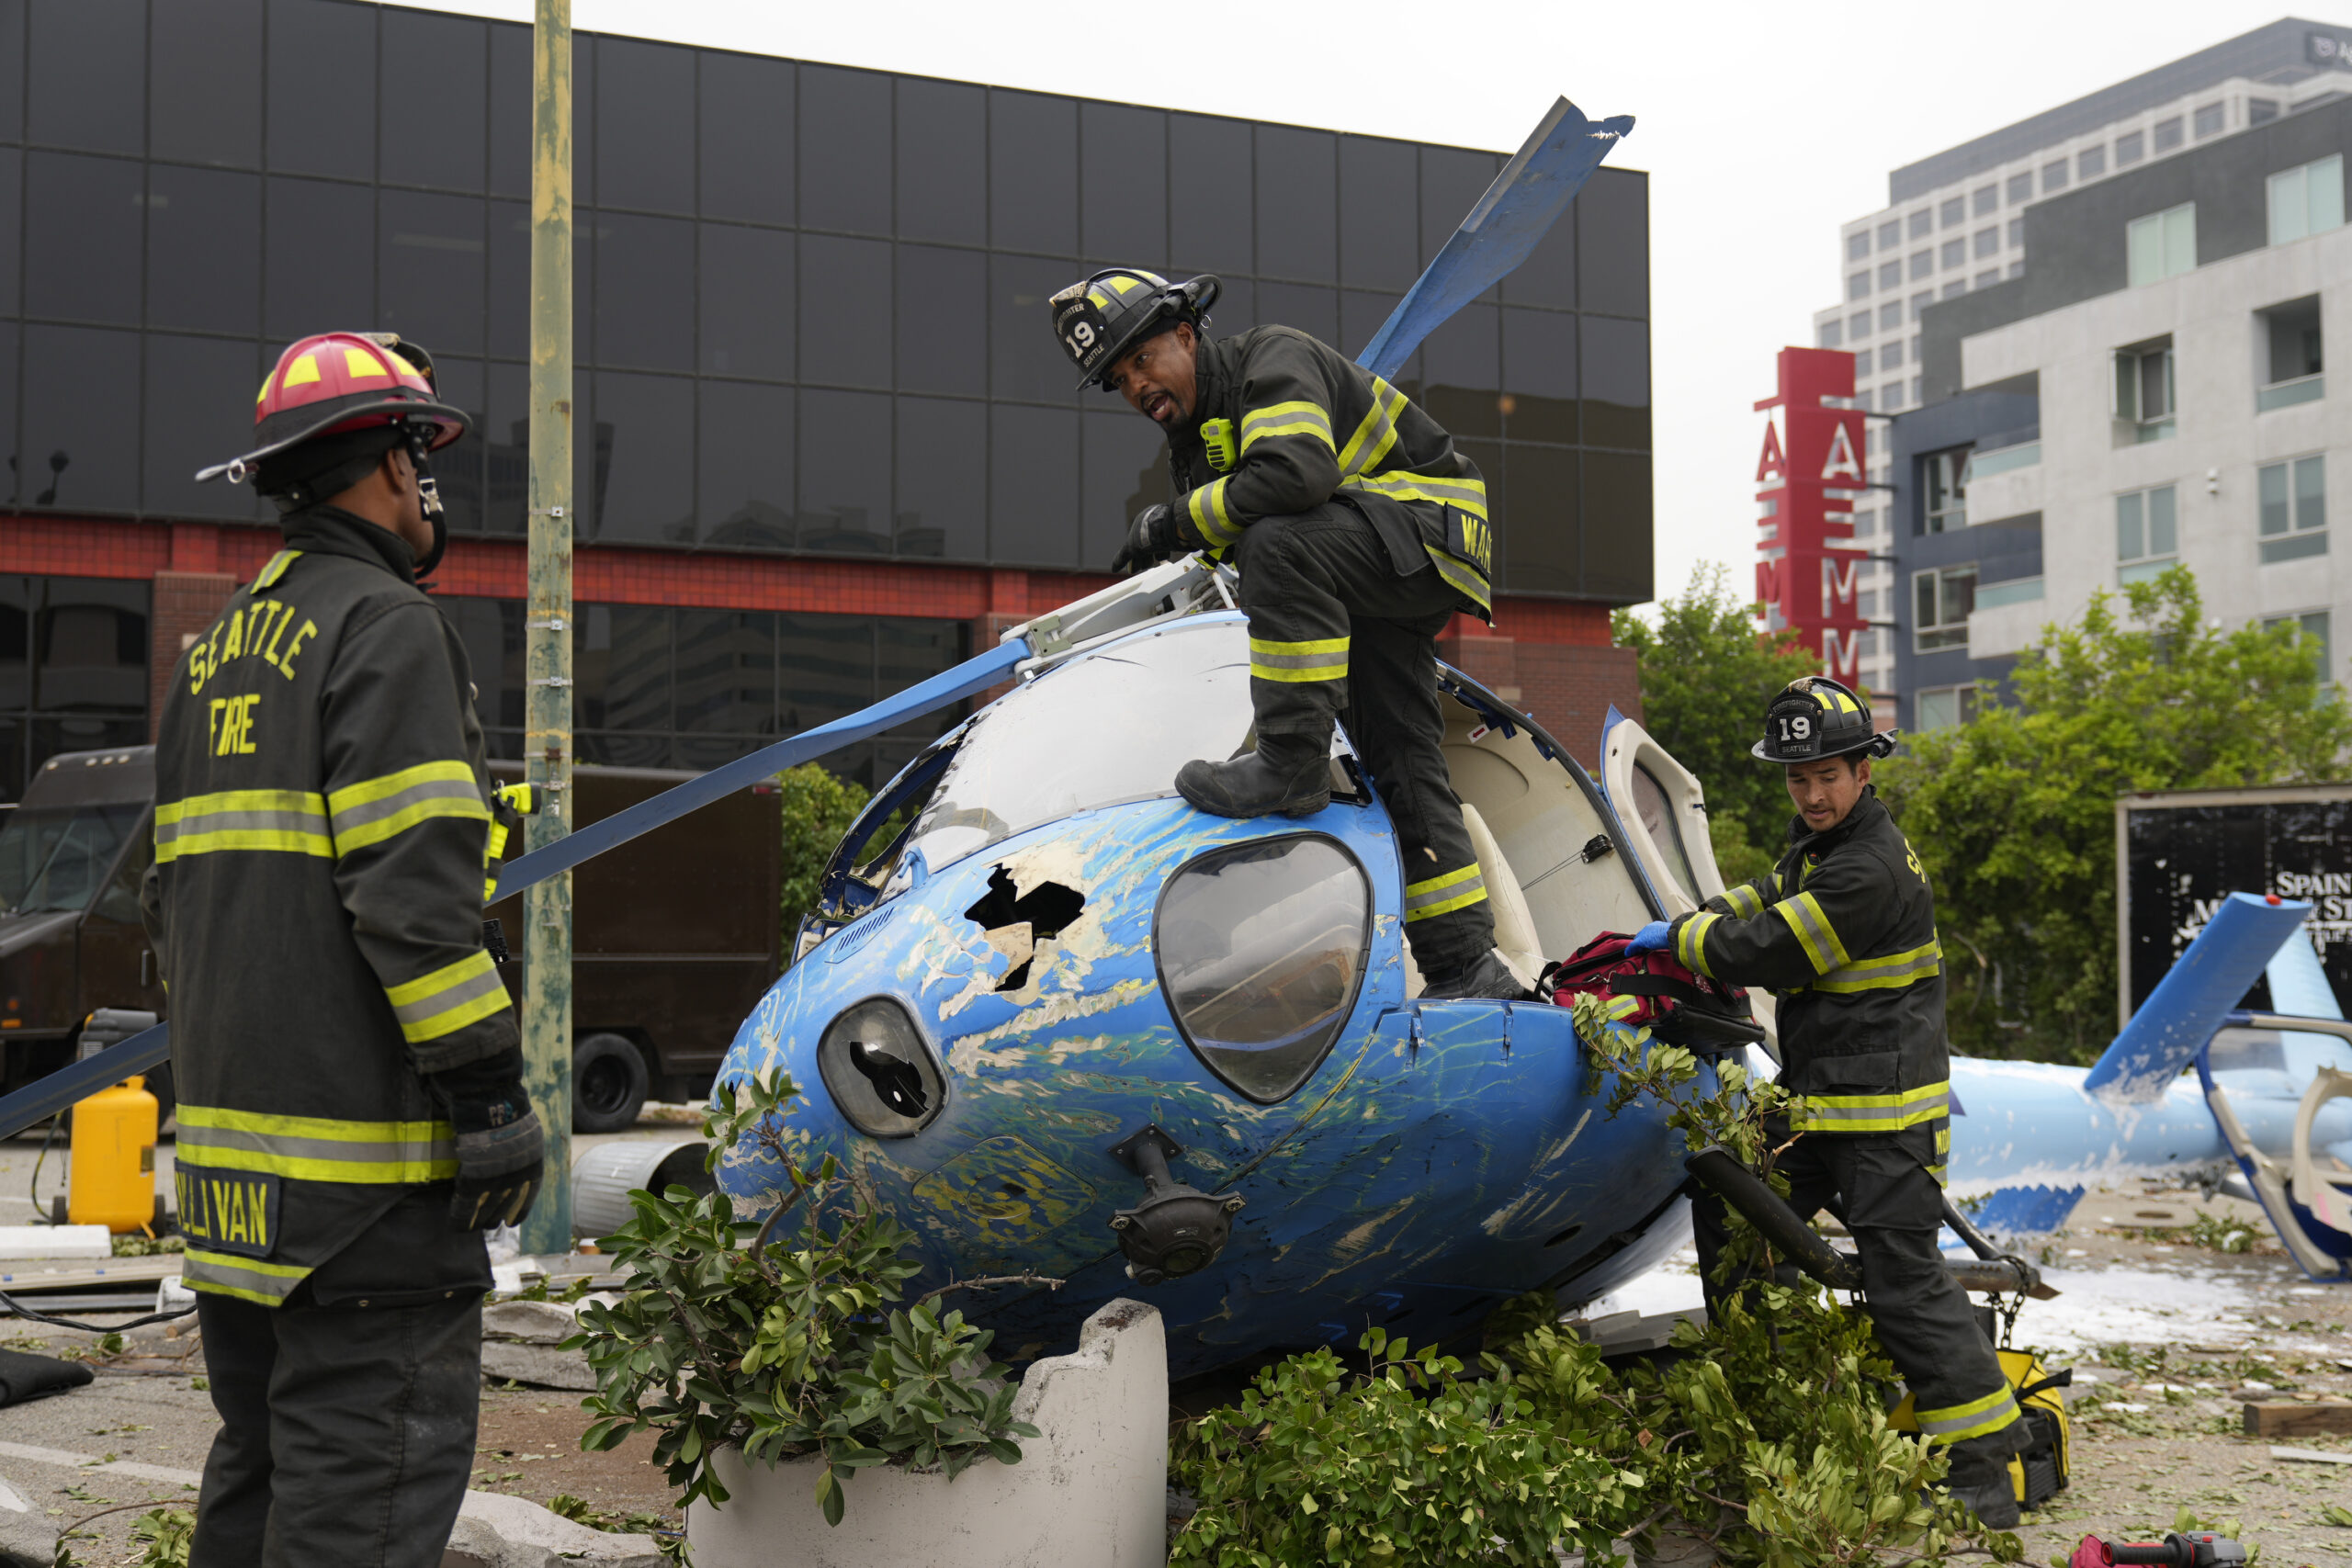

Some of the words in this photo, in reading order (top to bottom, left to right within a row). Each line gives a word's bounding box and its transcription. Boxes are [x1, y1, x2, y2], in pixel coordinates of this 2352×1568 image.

[1066, 321, 1095, 358] 19
[1083, 343, 1105, 367] SEATTLE
[188, 599, 318, 695] SEATTLE
[1772, 699, 1815, 714] FIREFIGHTER
[209, 694, 261, 758] FIRE
[1779, 716, 1811, 741] 19
[1781, 744, 1812, 753] SEATTLE
